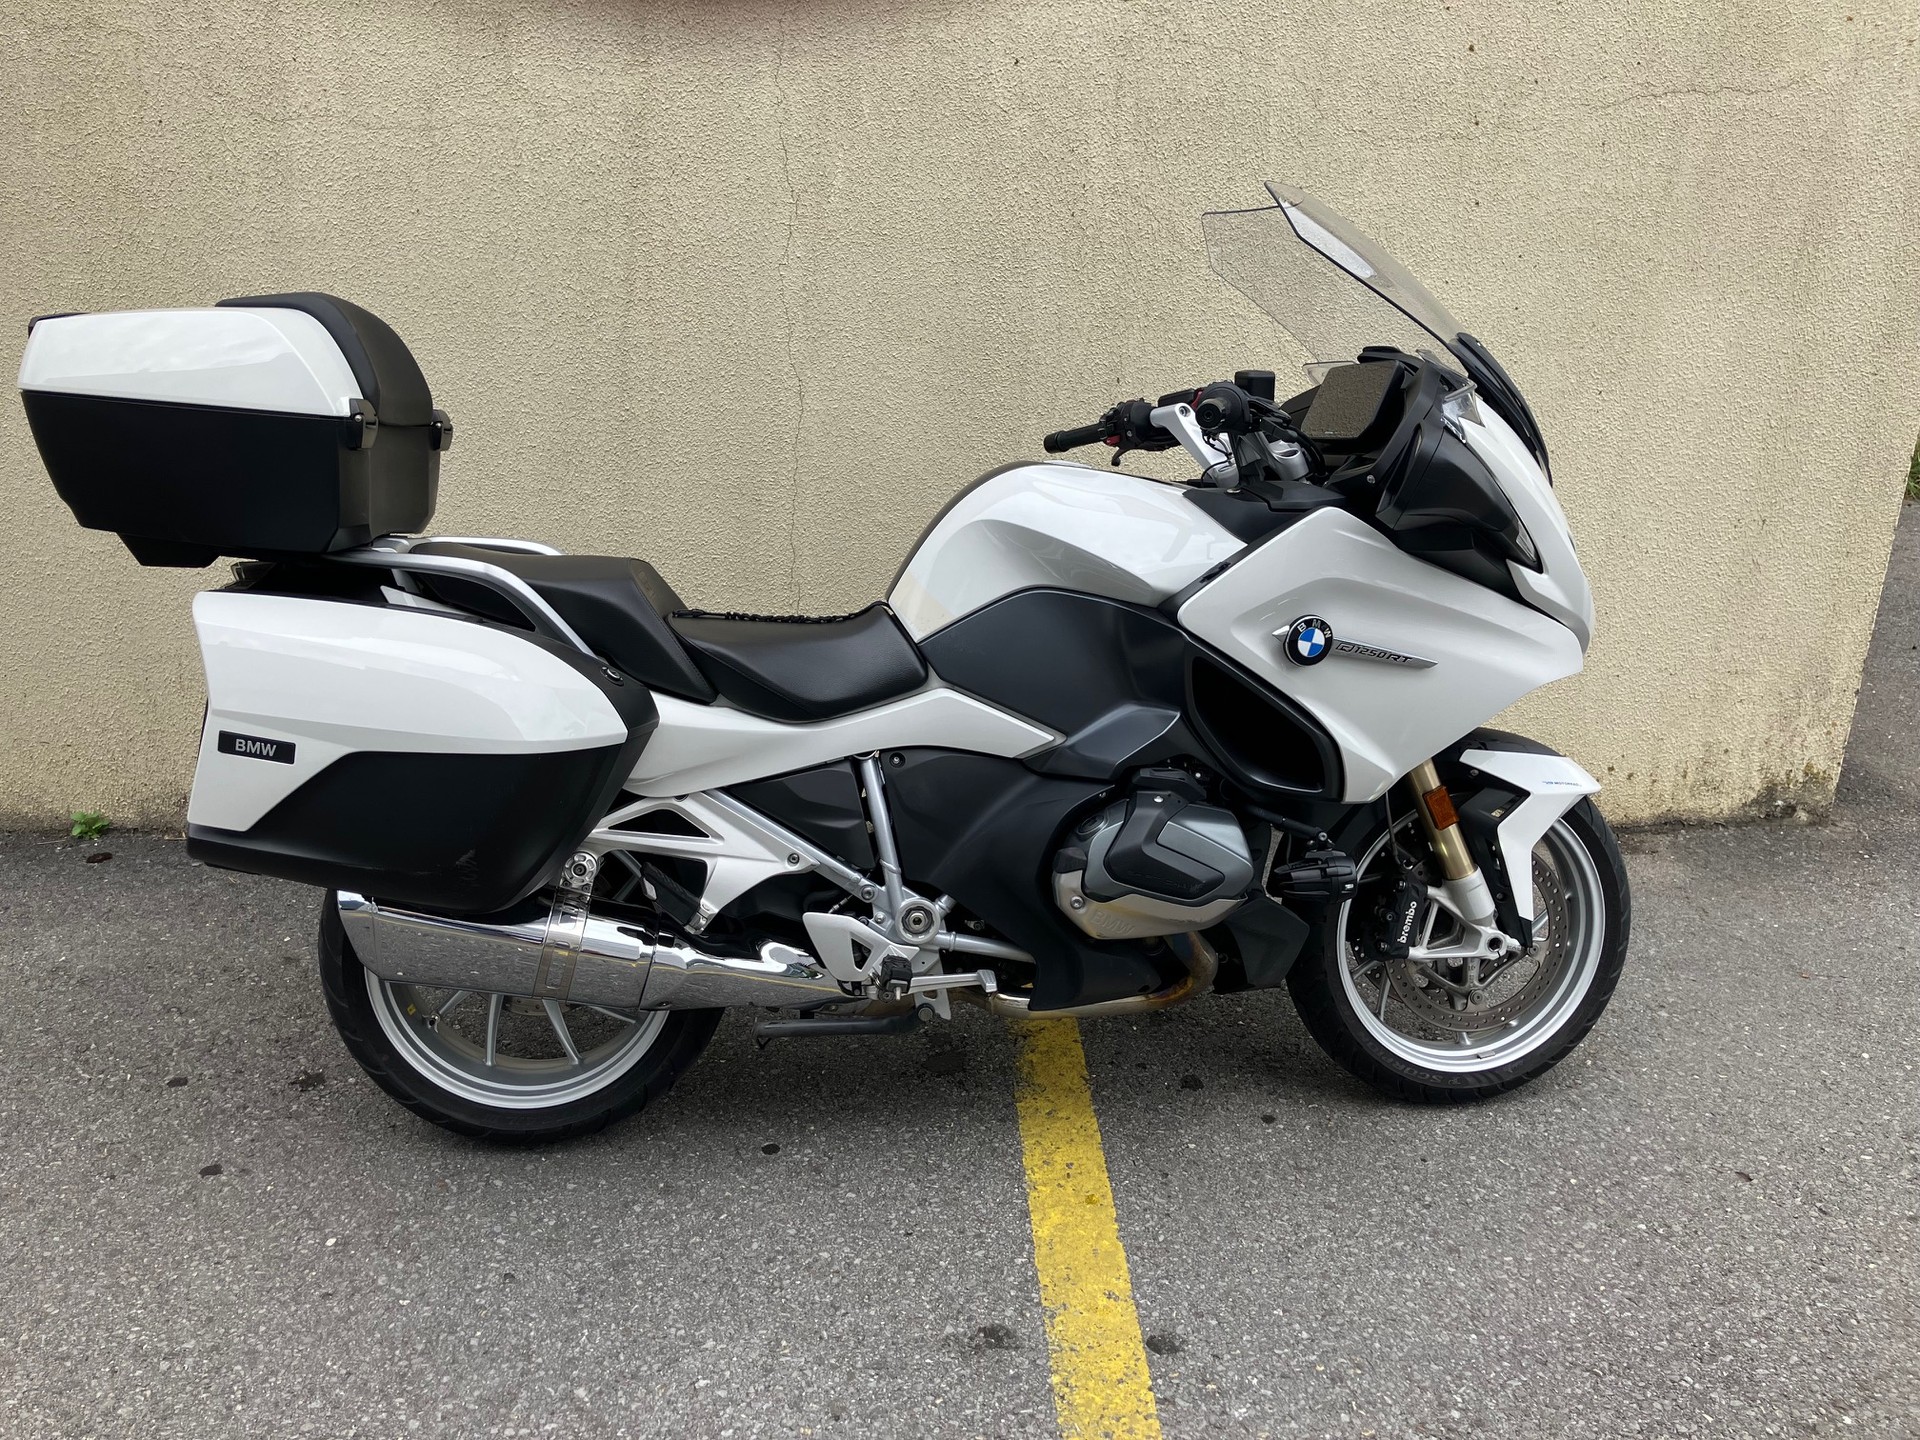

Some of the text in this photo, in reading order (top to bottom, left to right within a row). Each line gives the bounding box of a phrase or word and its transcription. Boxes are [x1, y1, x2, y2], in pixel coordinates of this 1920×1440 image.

[1297, 619, 1332, 639] BMW
[235, 739, 277, 757] BMW
[1091, 911, 1136, 936] BMW
[1397, 901, 1417, 943] brembo
